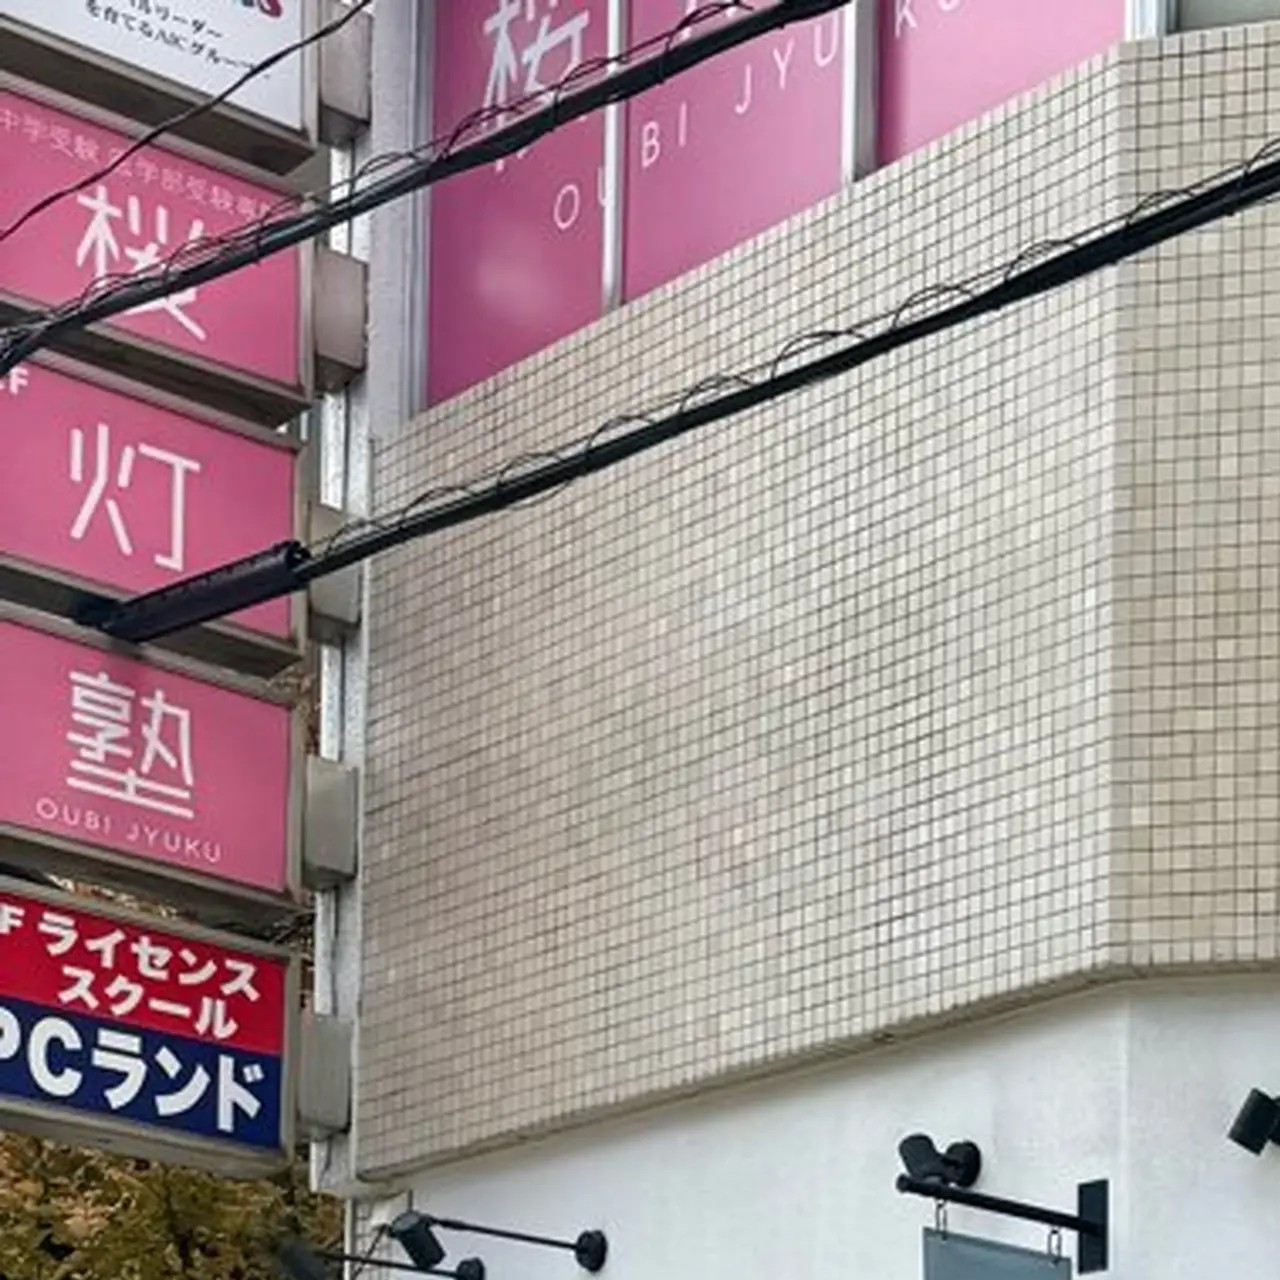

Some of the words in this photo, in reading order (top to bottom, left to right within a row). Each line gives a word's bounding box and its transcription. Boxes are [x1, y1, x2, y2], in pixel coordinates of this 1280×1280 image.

[734, 0, 960, 114] JYUK
[0, 366, 29, 395] F
[69, 423, 200, 572] 灯
[66, 671, 194, 819] 塾
[36, 797, 112, 835] OUBI
[126, 823, 222, 863] JYUKU
[38, 911, 261, 1002] ライセンス
[58, 964, 239, 1040] スクール
